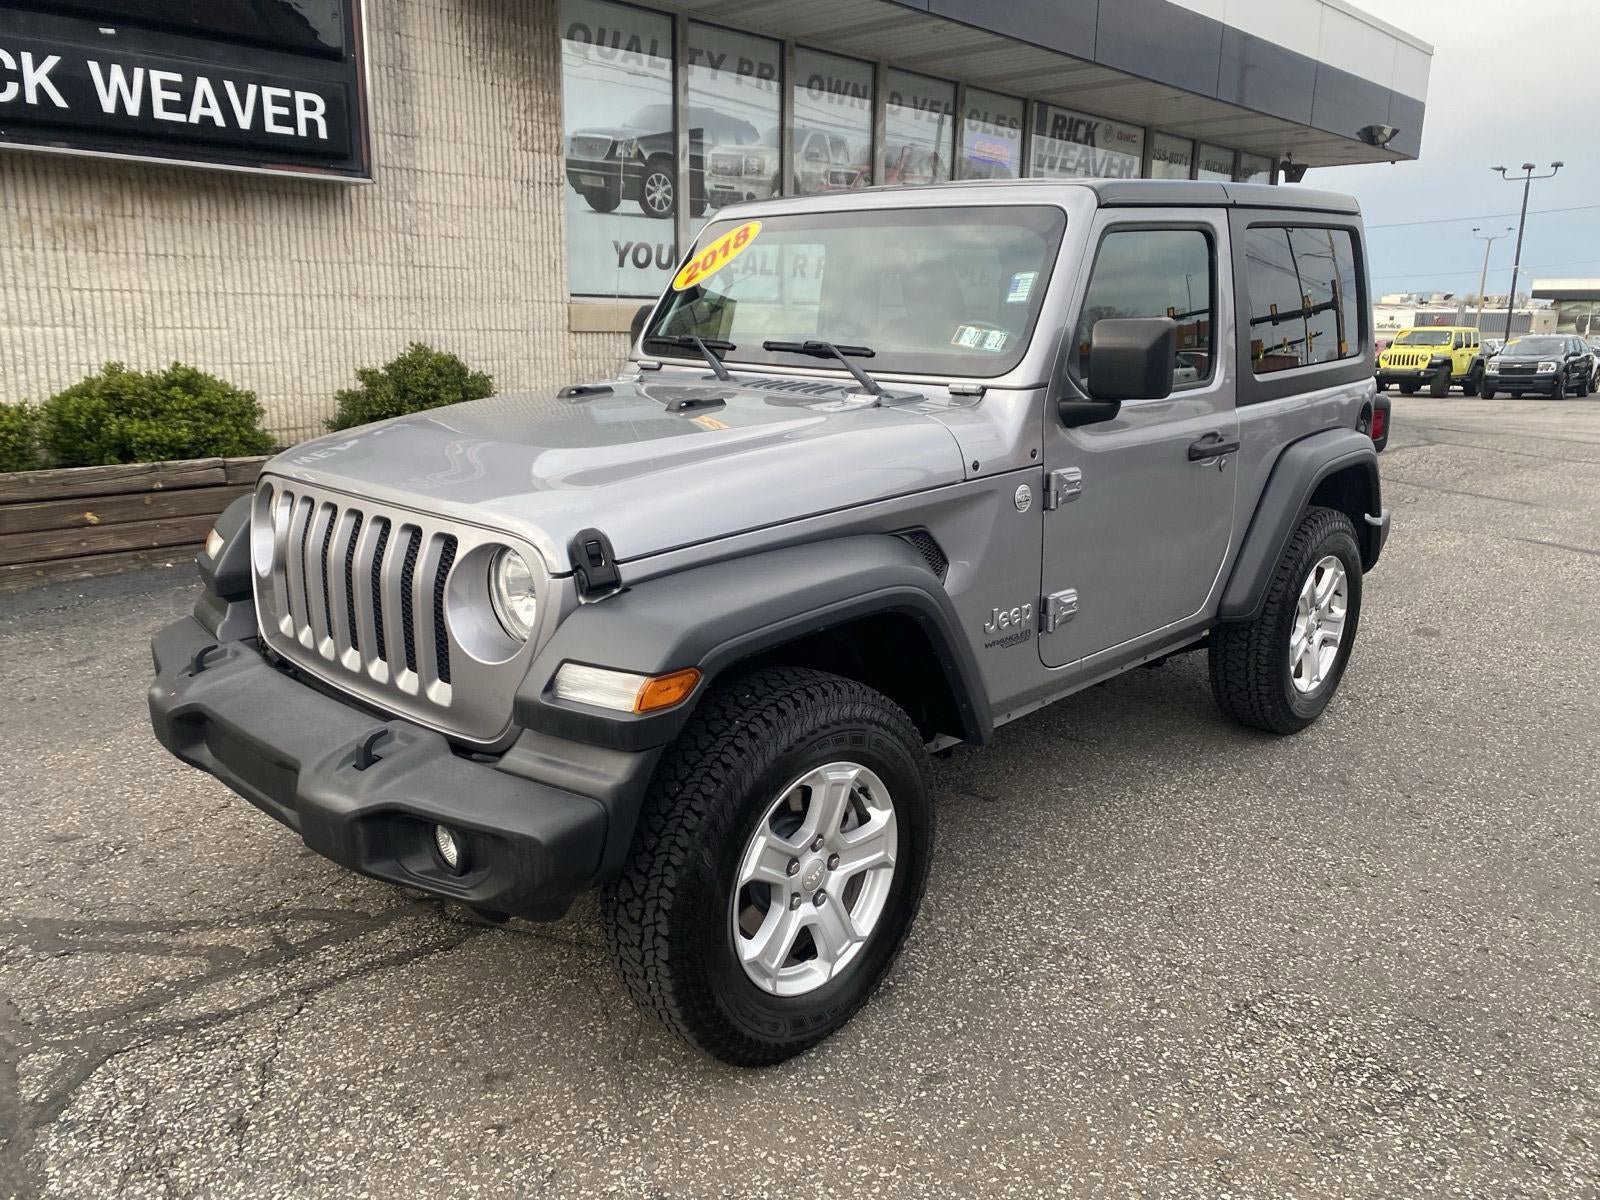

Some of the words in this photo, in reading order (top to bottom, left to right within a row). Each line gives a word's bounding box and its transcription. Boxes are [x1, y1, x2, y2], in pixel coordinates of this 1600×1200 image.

[565, 21, 726, 81] QUALTY
[913, 94, 1019, 139] VEHCLES
[87, 60, 328, 139] WEAVER
[1050, 113, 1099, 147] RICK
[1116, 130, 1137, 144] GMC
[612, 240, 673, 270] YOU
[683, 225, 751, 286] 2018
[984, 603, 1031, 634] Jeep
